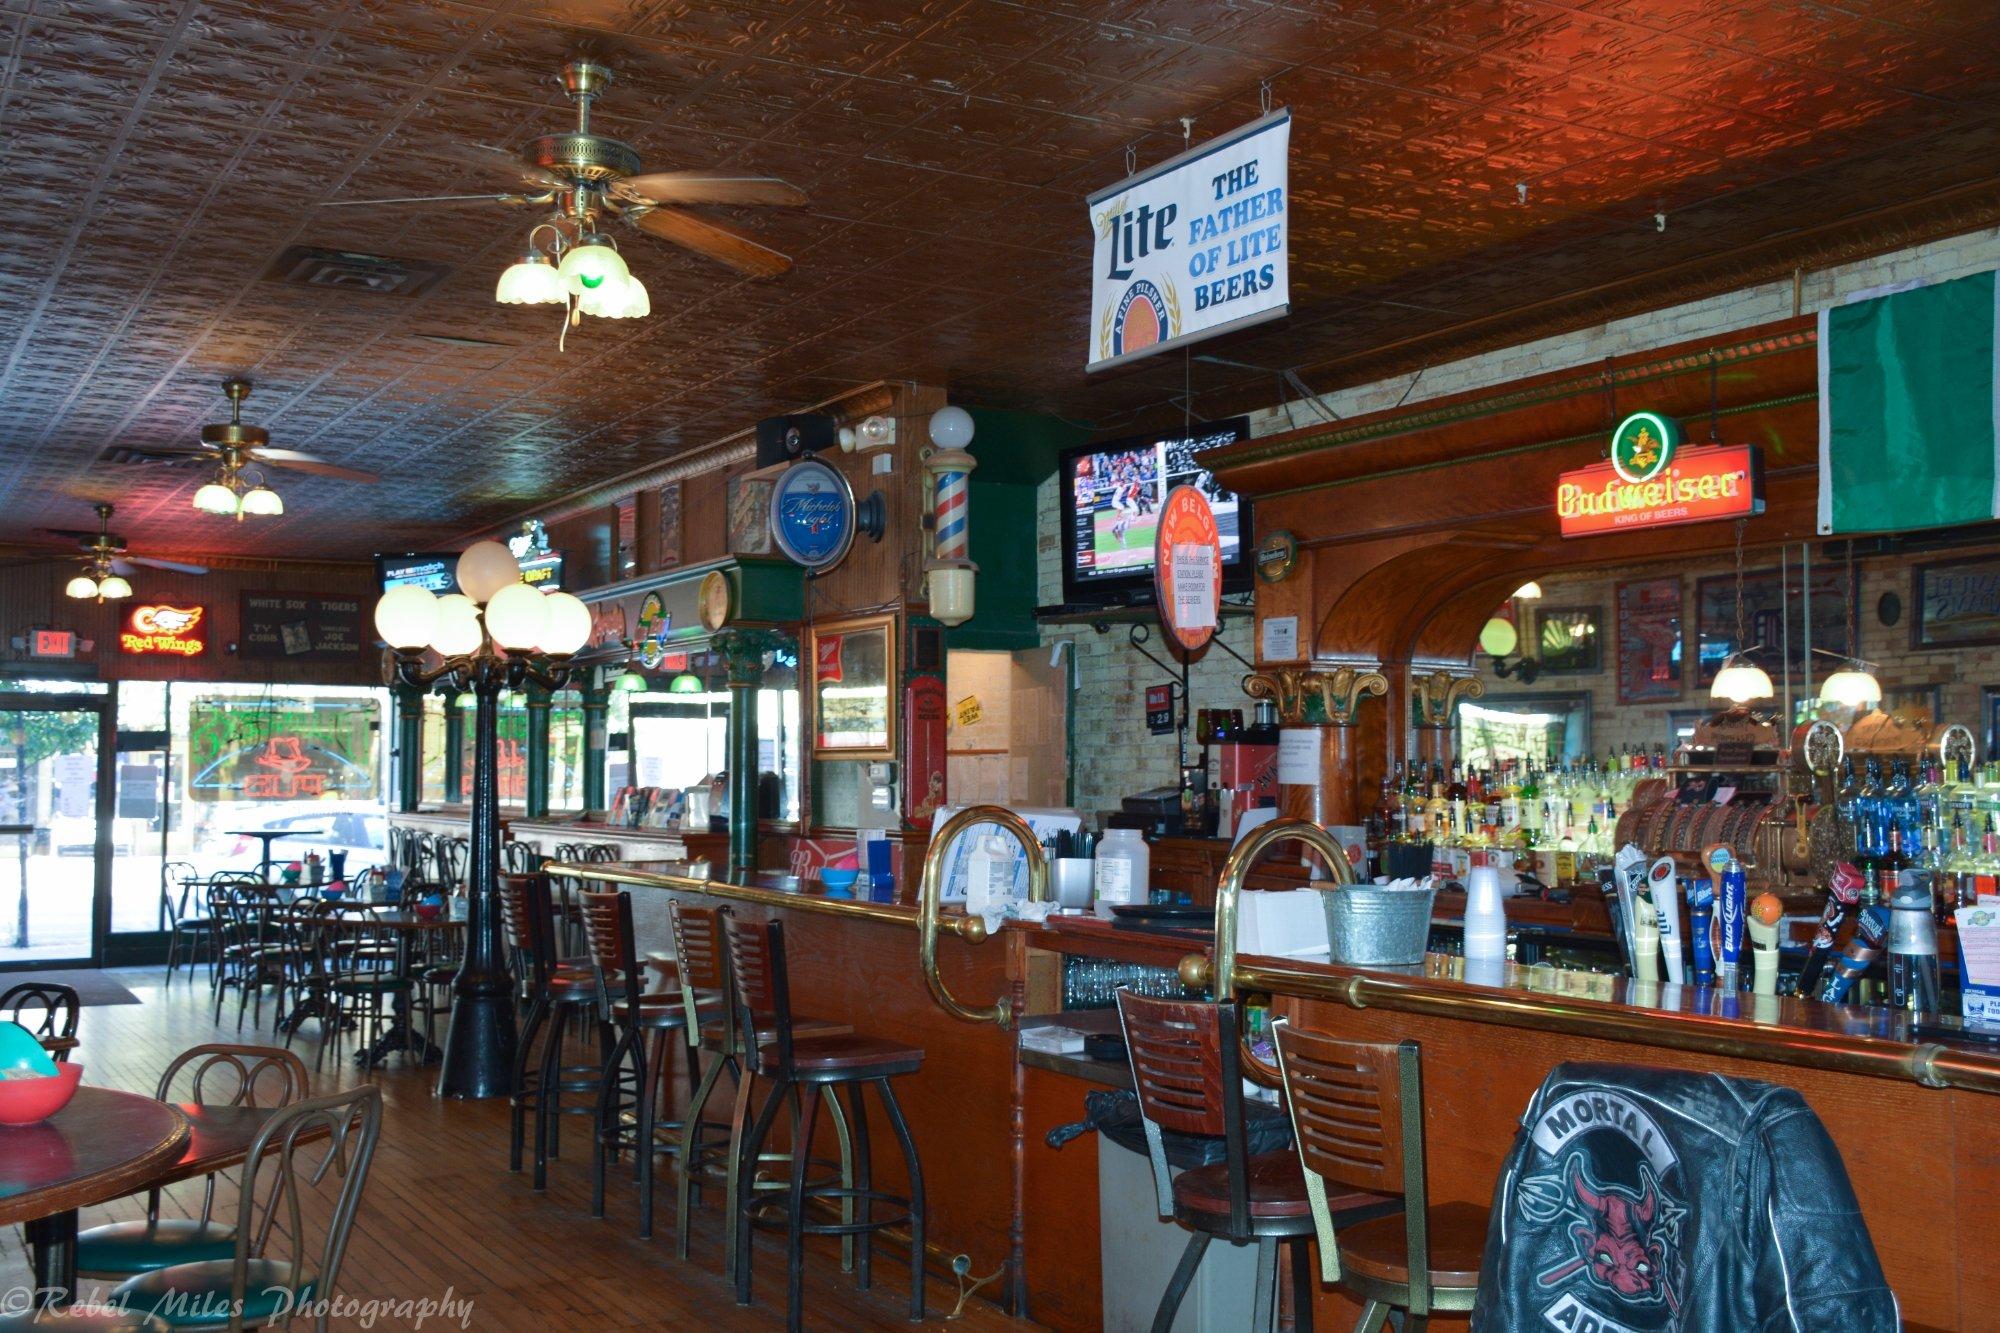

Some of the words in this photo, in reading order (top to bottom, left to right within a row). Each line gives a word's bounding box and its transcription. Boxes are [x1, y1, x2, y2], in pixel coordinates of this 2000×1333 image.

[1212, 159, 1259, 201] THE
[1096, 194, 1130, 240] Miller
[1188, 187, 1284, 245] FATHER
[1107, 203, 1177, 280] Lite
[1188, 246, 1222, 278] OF
[1227, 223, 1281, 267] LITE
[1118, 289, 1135, 321] FINE
[1136, 283, 1165, 321] PILSNER
[1194, 264, 1274, 311] BEERS
[1558, 467, 1745, 518] Budweiser
[1615, 512, 1638, 525] KING
[1639, 510, 1653, 521] OF
[1654, 506, 1688, 520] BEERS
[1163, 508, 1178, 566] NEW
[386, 569, 405, 577] PLAY
[248, 599, 281, 609] WHITE
[286, 600, 307, 609] SOX
[320, 602, 358, 611] TIGERS
[37, 632, 68, 654] EXIT
[121, 634, 154, 653] Red
[153, 635, 203, 656] Wings
[315, 642, 359, 652] JACKSON
[324, 632, 344, 641] JOE
[1724, 924, 1734, 951] BUD
[1545, 1097, 1655, 1156] MORTAL
